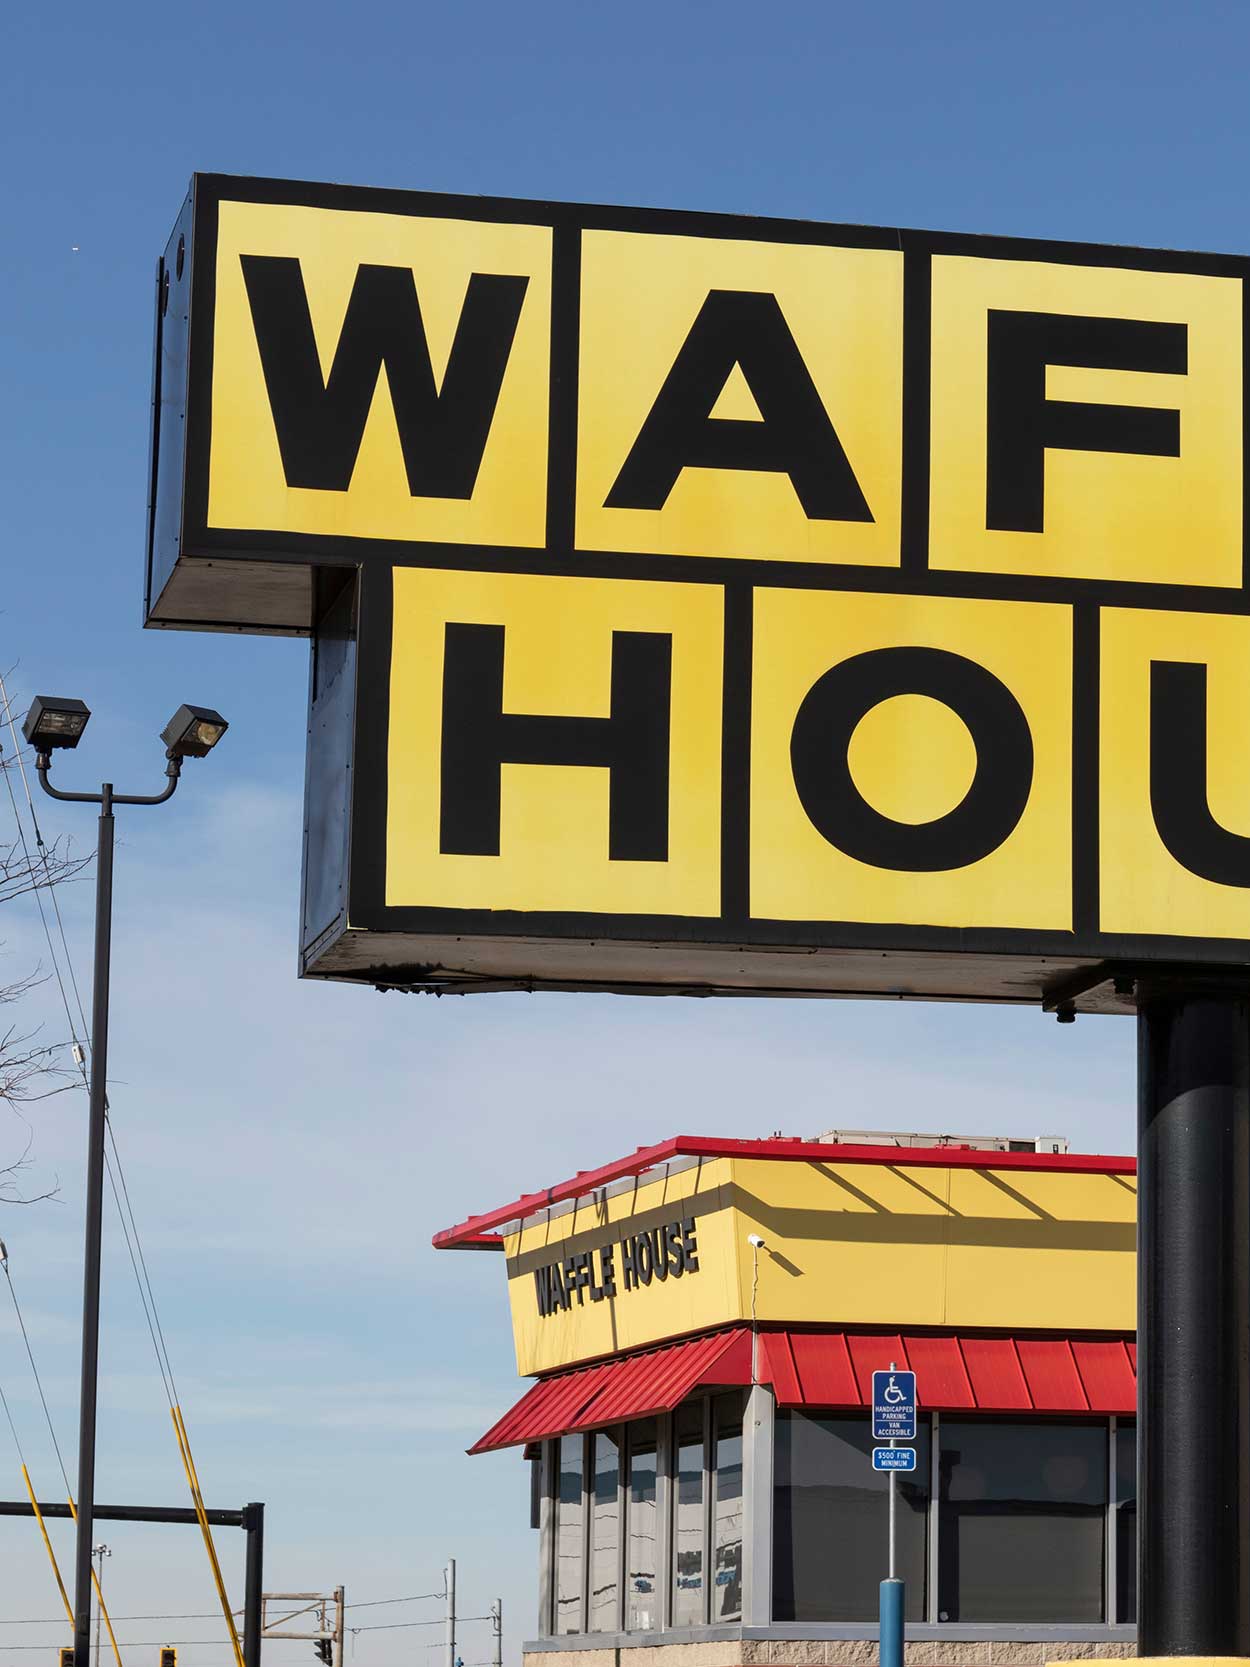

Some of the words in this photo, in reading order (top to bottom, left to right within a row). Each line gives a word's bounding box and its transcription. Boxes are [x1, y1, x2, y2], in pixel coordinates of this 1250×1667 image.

[535, 1245, 616, 1317] WAFFLE
[621, 1217, 699, 1291] HOUSE
[878, 1452, 894, 1460] $500
[896, 1452, 910, 1460] FINE
